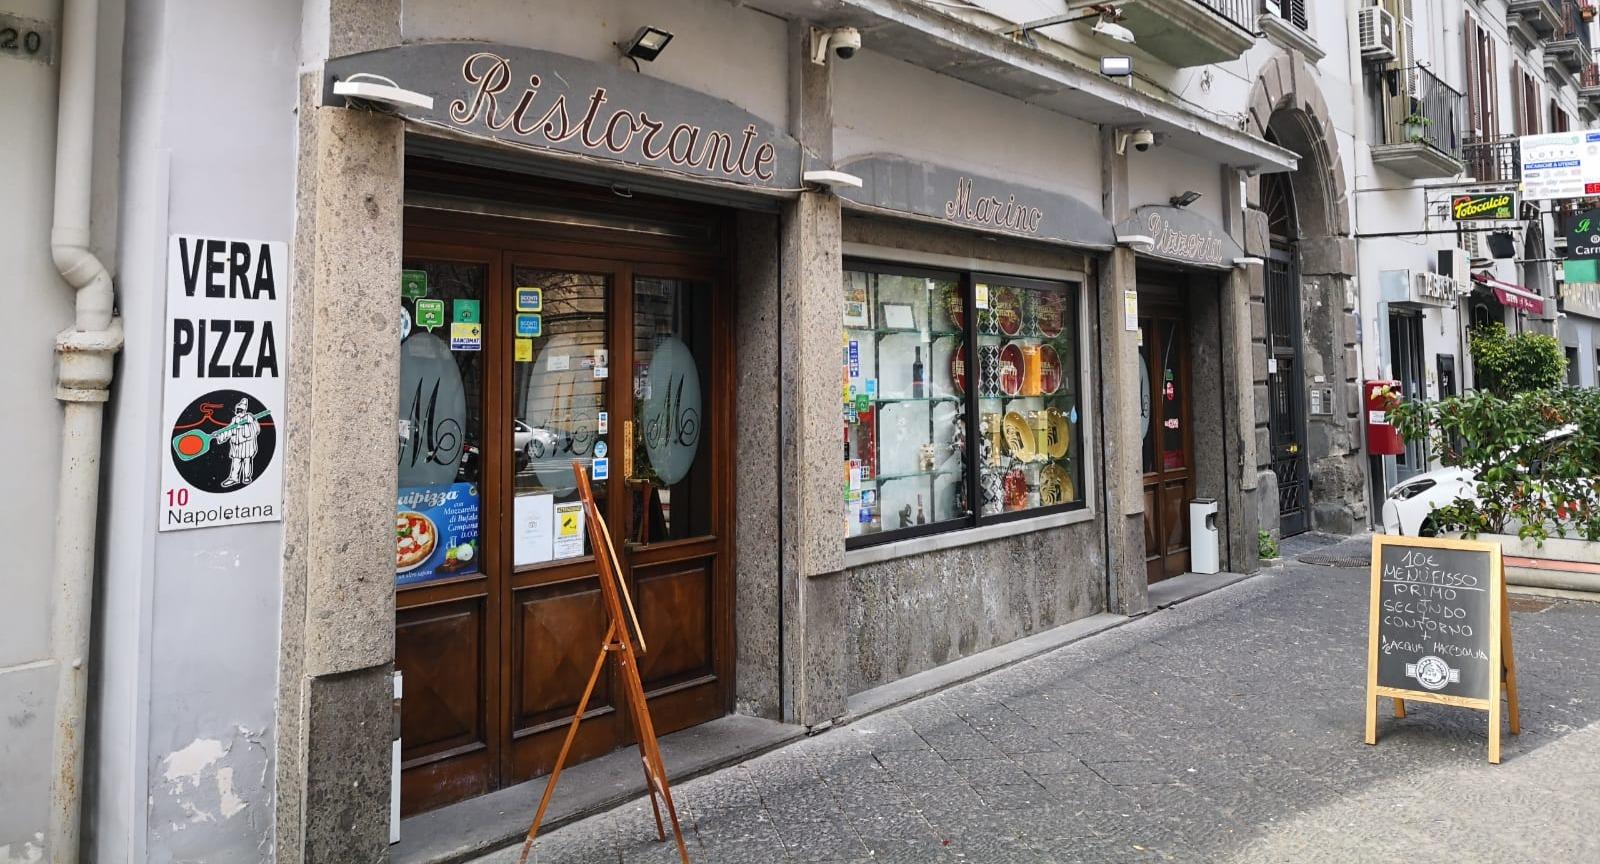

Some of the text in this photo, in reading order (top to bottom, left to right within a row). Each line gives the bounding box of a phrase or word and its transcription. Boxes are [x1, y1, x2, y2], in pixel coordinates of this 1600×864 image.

[450, 53, 775, 181] Ristorante
[945, 176, 1043, 232] Marino
[1455, 195, 1510, 219] Totocalcio
[178, 237, 276, 300] VERA
[172, 318, 279, 379] PIZZA
[166, 489, 189, 506] 10
[397, 490, 459, 509] uipizza
[167, 504, 274, 525] Napoletana
[1401, 550, 1440, 568] 10€
[1393, 583, 1457, 601] PRIMO
[1384, 616, 1473, 637] CONTORNO
